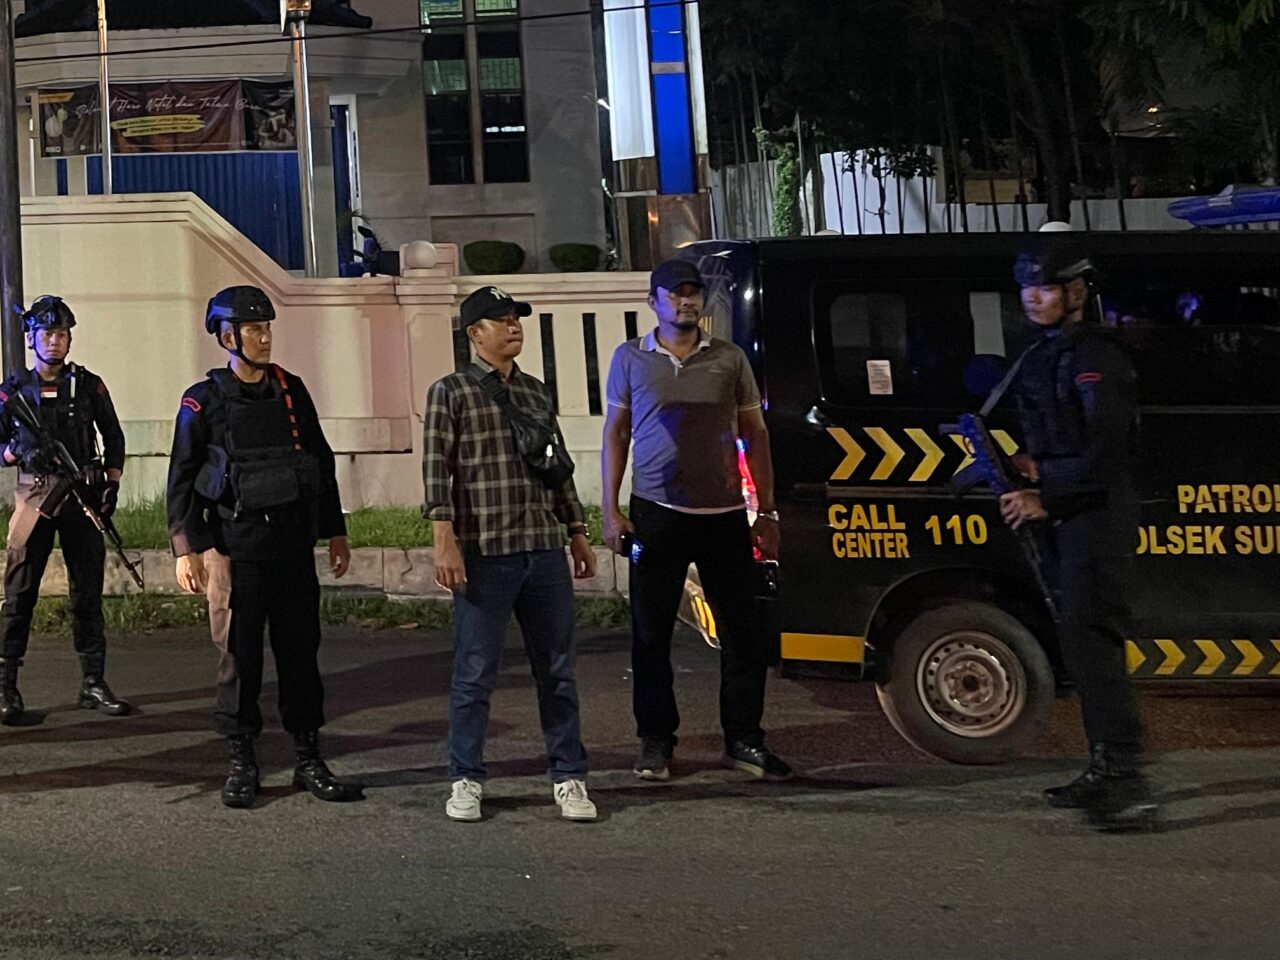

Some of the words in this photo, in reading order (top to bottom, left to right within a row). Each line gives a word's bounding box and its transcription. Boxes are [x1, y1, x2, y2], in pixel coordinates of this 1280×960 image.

[828, 503, 907, 530] CALL
[925, 513, 988, 546] 110
[831, 532, 911, 559] CENTER
[1234, 524, 1280, 556] SU
